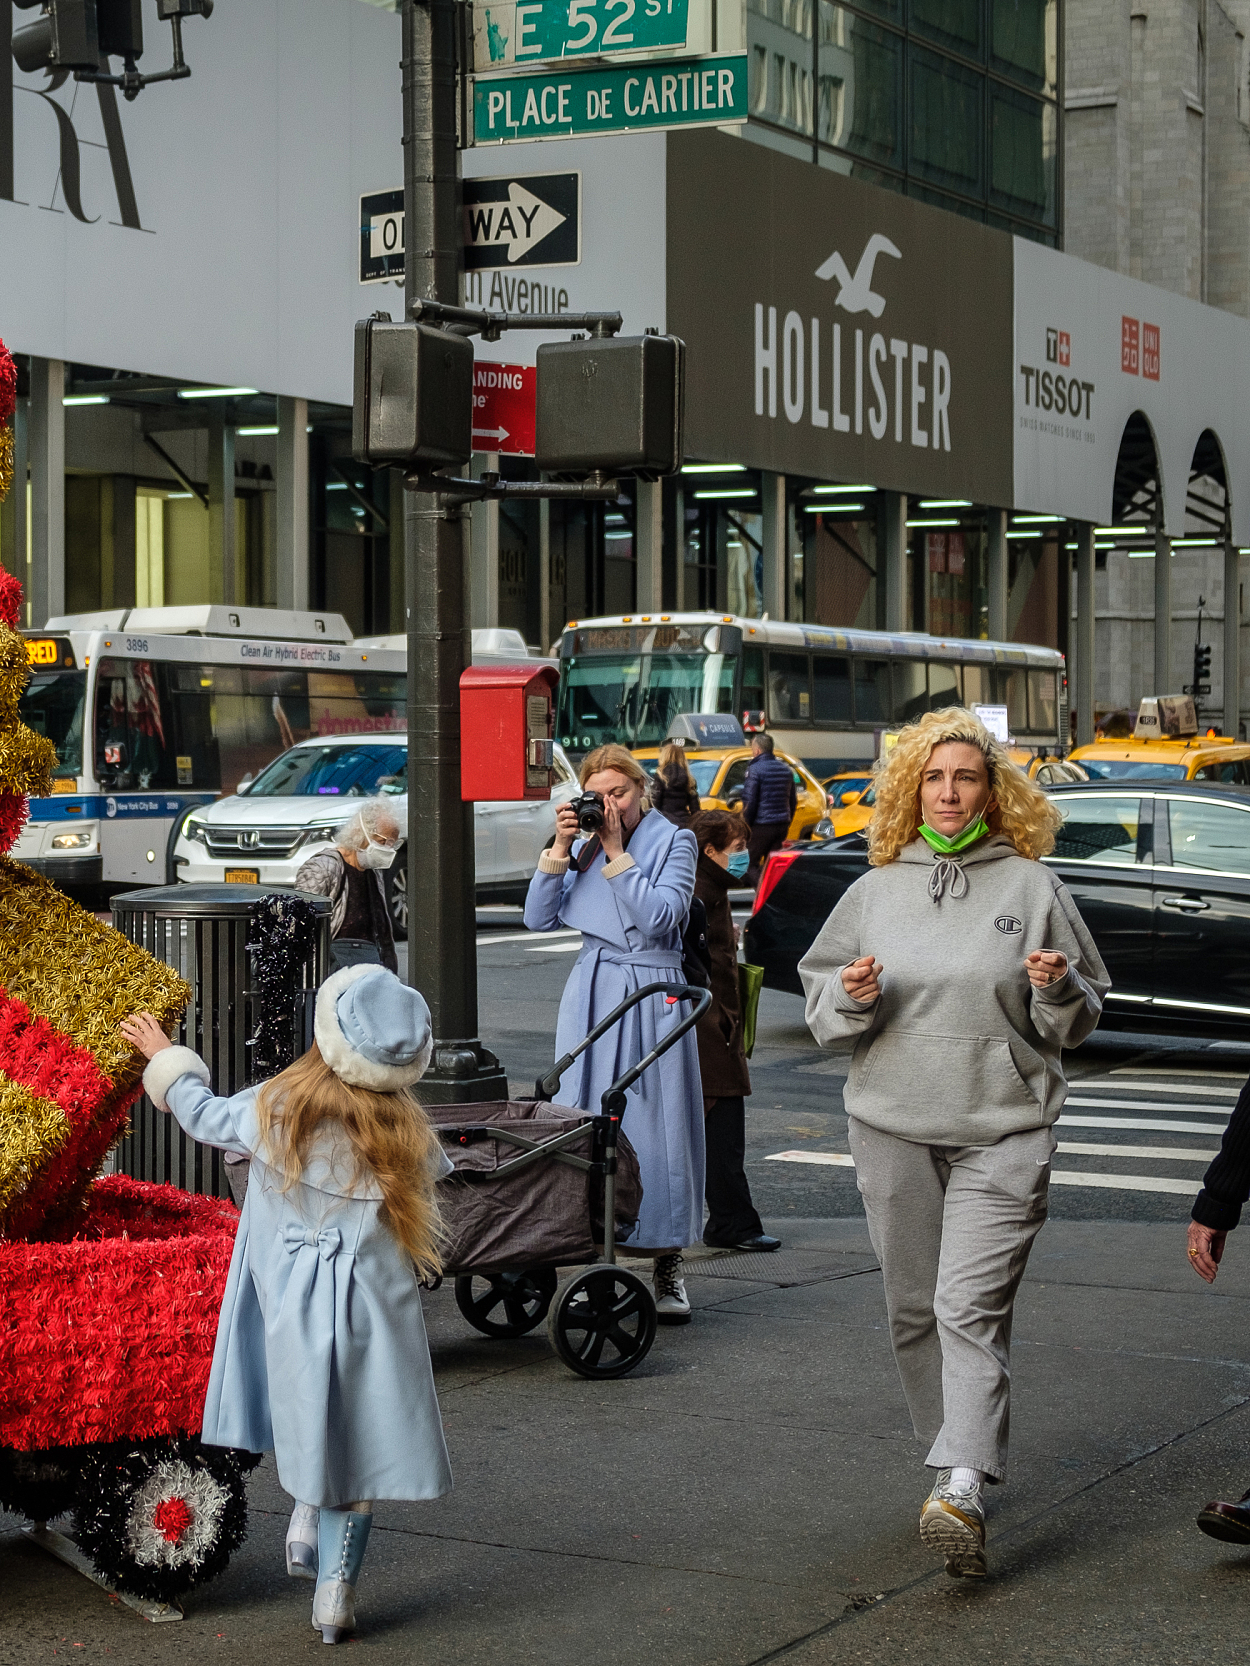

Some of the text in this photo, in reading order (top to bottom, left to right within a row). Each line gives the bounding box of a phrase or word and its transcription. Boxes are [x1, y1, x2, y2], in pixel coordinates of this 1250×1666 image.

[516, 4, 543, 57] E
[566, 0, 636, 50] 52
[488, 69, 735, 129] PLACE DE CARTIER
[468, 204, 541, 243] WAY
[490, 271, 569, 314] Avenue
[754, 302, 951, 452] HOLLISTER
[1020, 365, 1095, 420] TISSOT
[126, 638, 149, 653] 3896
[240, 644, 341, 661] Clean Air Hybrid Electric Bus
[709, 724, 736, 733] CAPSULE
